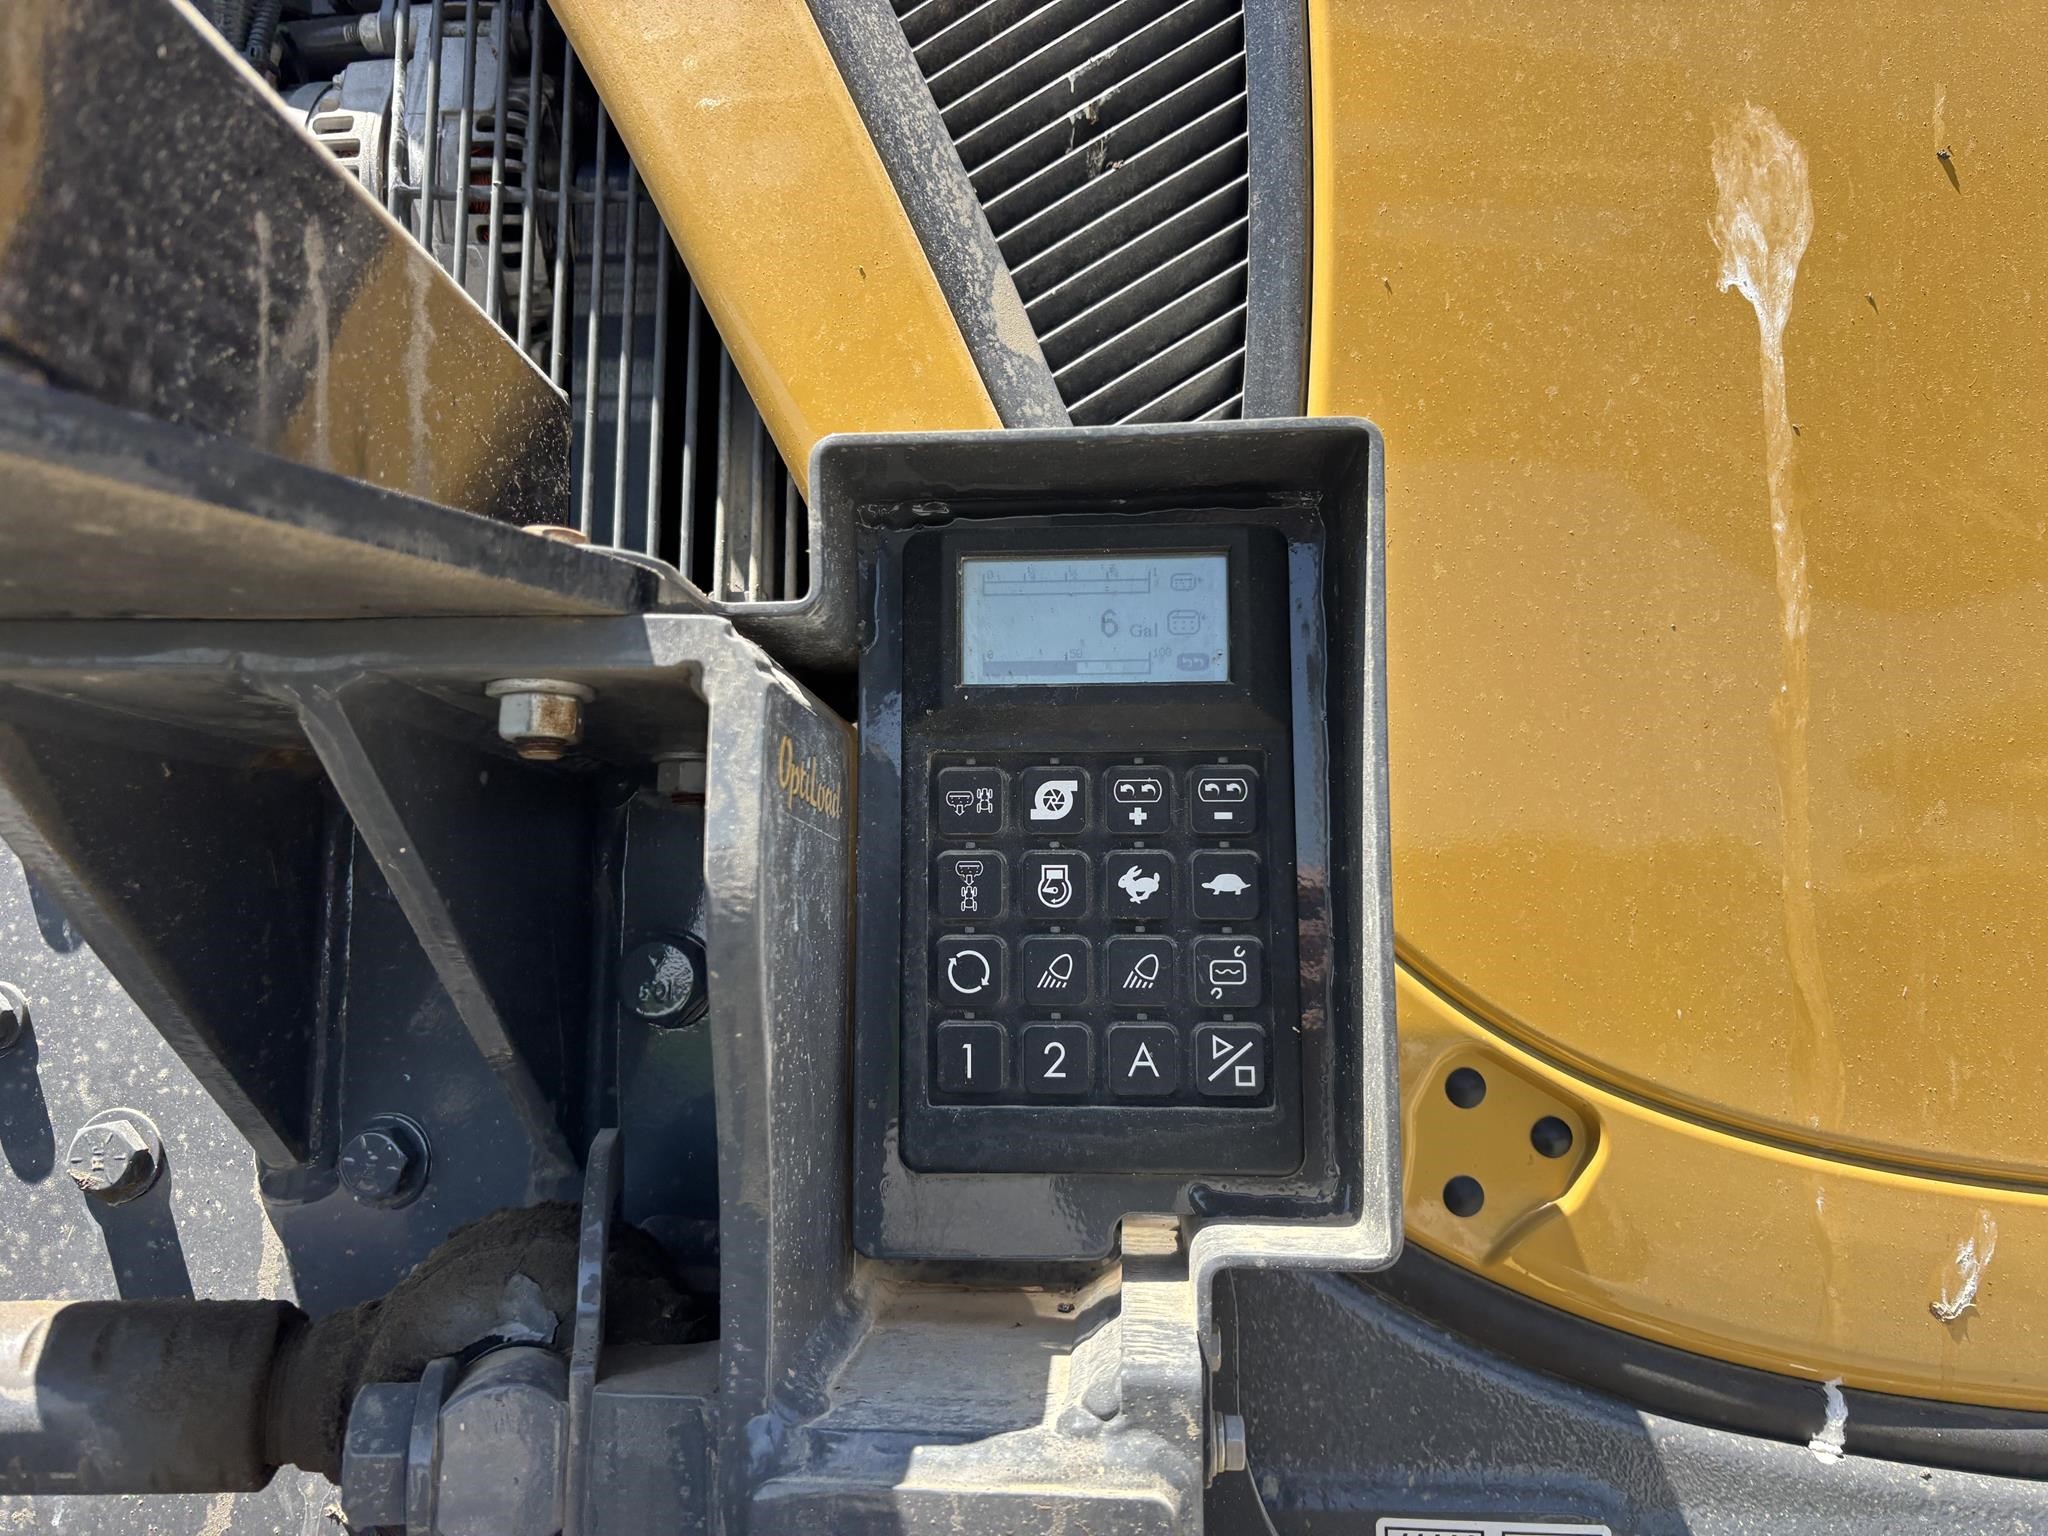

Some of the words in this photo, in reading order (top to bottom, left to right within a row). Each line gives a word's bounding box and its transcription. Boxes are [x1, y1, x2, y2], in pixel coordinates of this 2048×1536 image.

[1101, 609, 1119, 638] 6
[1130, 622, 1158, 638] Gal
[962, 1043, 972, 1079] 1
[1043, 1041, 1066, 1078] 2
[1128, 1042, 1160, 1077] A
